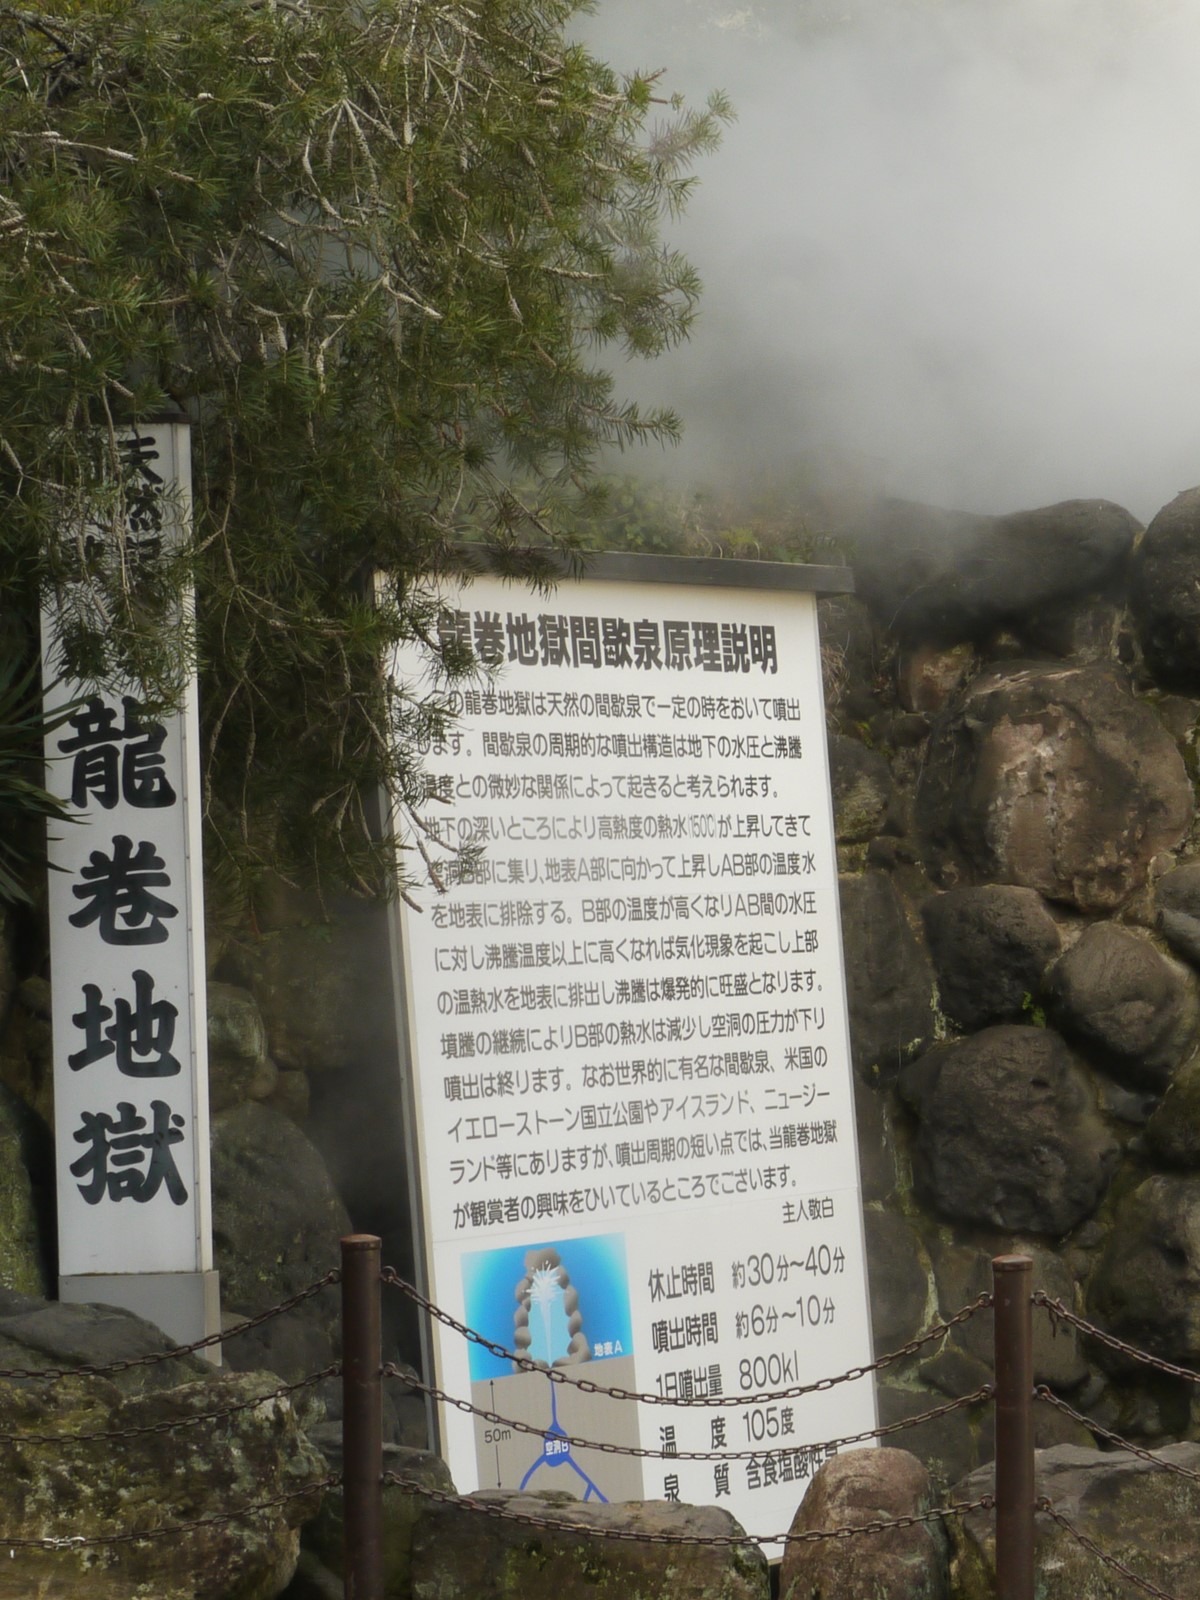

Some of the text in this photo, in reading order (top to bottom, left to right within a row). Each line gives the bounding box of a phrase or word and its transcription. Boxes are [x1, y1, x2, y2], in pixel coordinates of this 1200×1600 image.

[57, 695, 188, 1205] 龍巻地獄
[782, 1196, 834, 1224] 主人敬白
[648, 1261, 715, 1303] 休止時間
[651, 1311, 718, 1354] 噴出時間
[656, 1363, 723, 1402] 1日噴出量
[484, 1428, 512, 1443] 50m
[743, 1405, 795, 1442] 105度
